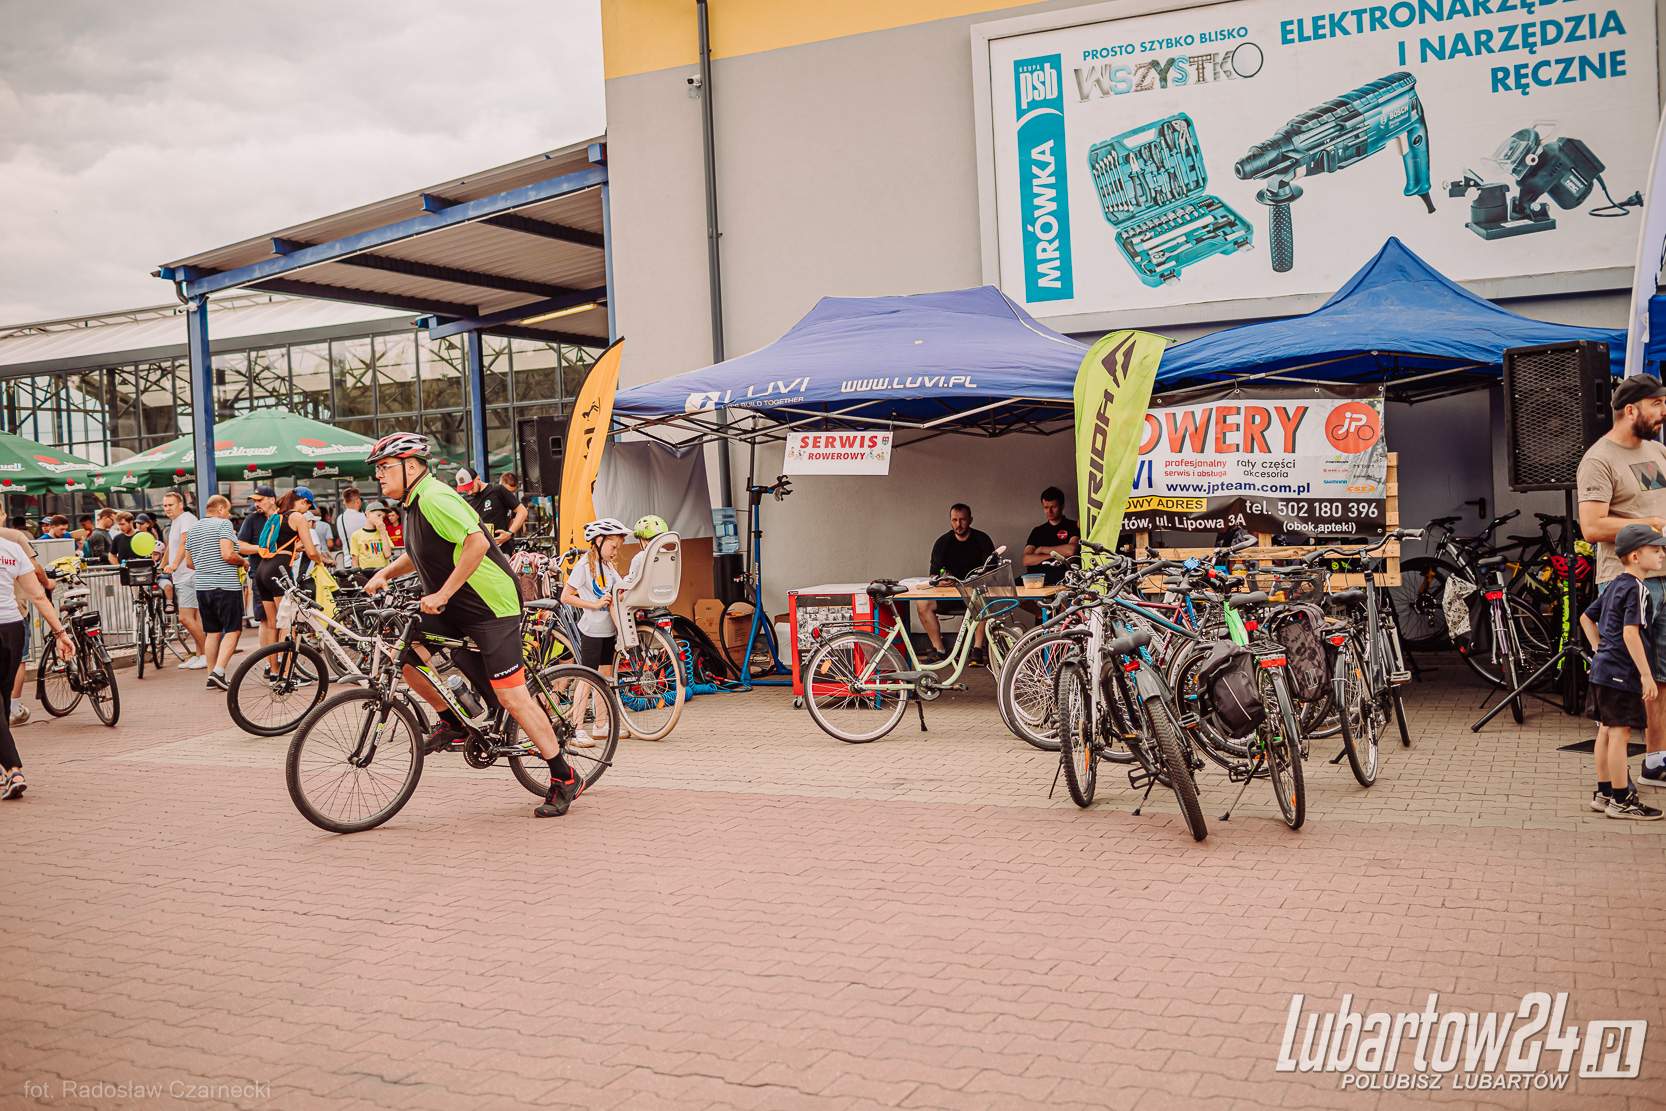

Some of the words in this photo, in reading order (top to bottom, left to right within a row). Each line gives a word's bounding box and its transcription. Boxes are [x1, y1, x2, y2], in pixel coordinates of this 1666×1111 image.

[1083, 44, 1135, 61] PROSTO
[1140, 35, 1195, 53] SZYBKO
[1199, 26, 1248, 44] BLISKO
[1398, 41, 1406, 66] I
[1420, 10, 1627, 64] NARZĘDZIA
[1073, 42, 1264, 103] WSZYSTKO
[1491, 50, 1627, 96] RĘCZNE
[1019, 63, 1059, 109] psb
[1027, 139, 1061, 288] MRÓWKA
[1138, 405, 1308, 455] OWERY
[800, 435, 878, 448] SERWIS
[808, 452, 866, 460] ROWEROWY
[1236, 459, 1257, 470] raty
[1261, 458, 1296, 470] części
[1164, 469, 1190, 477] serwis
[1165, 459, 1227, 474] profesjonalny
[1243, 469, 1289, 478] akcesoria
[1165, 481, 1311, 495] www.jpteam.com.pl
[1157, 498, 1203, 509] ADRES
[1246, 501, 1271, 515] tel.
[1278, 502, 1308, 517] 502
[1314, 502, 1341, 517] 180
[1348, 503, 1378, 518] 396
[1120, 516, 1152, 530] rtów,
[1156, 515, 1171, 527] ul.
[1175, 516, 1224, 531] Lipowa
[1228, 513, 1246, 526] 3A
